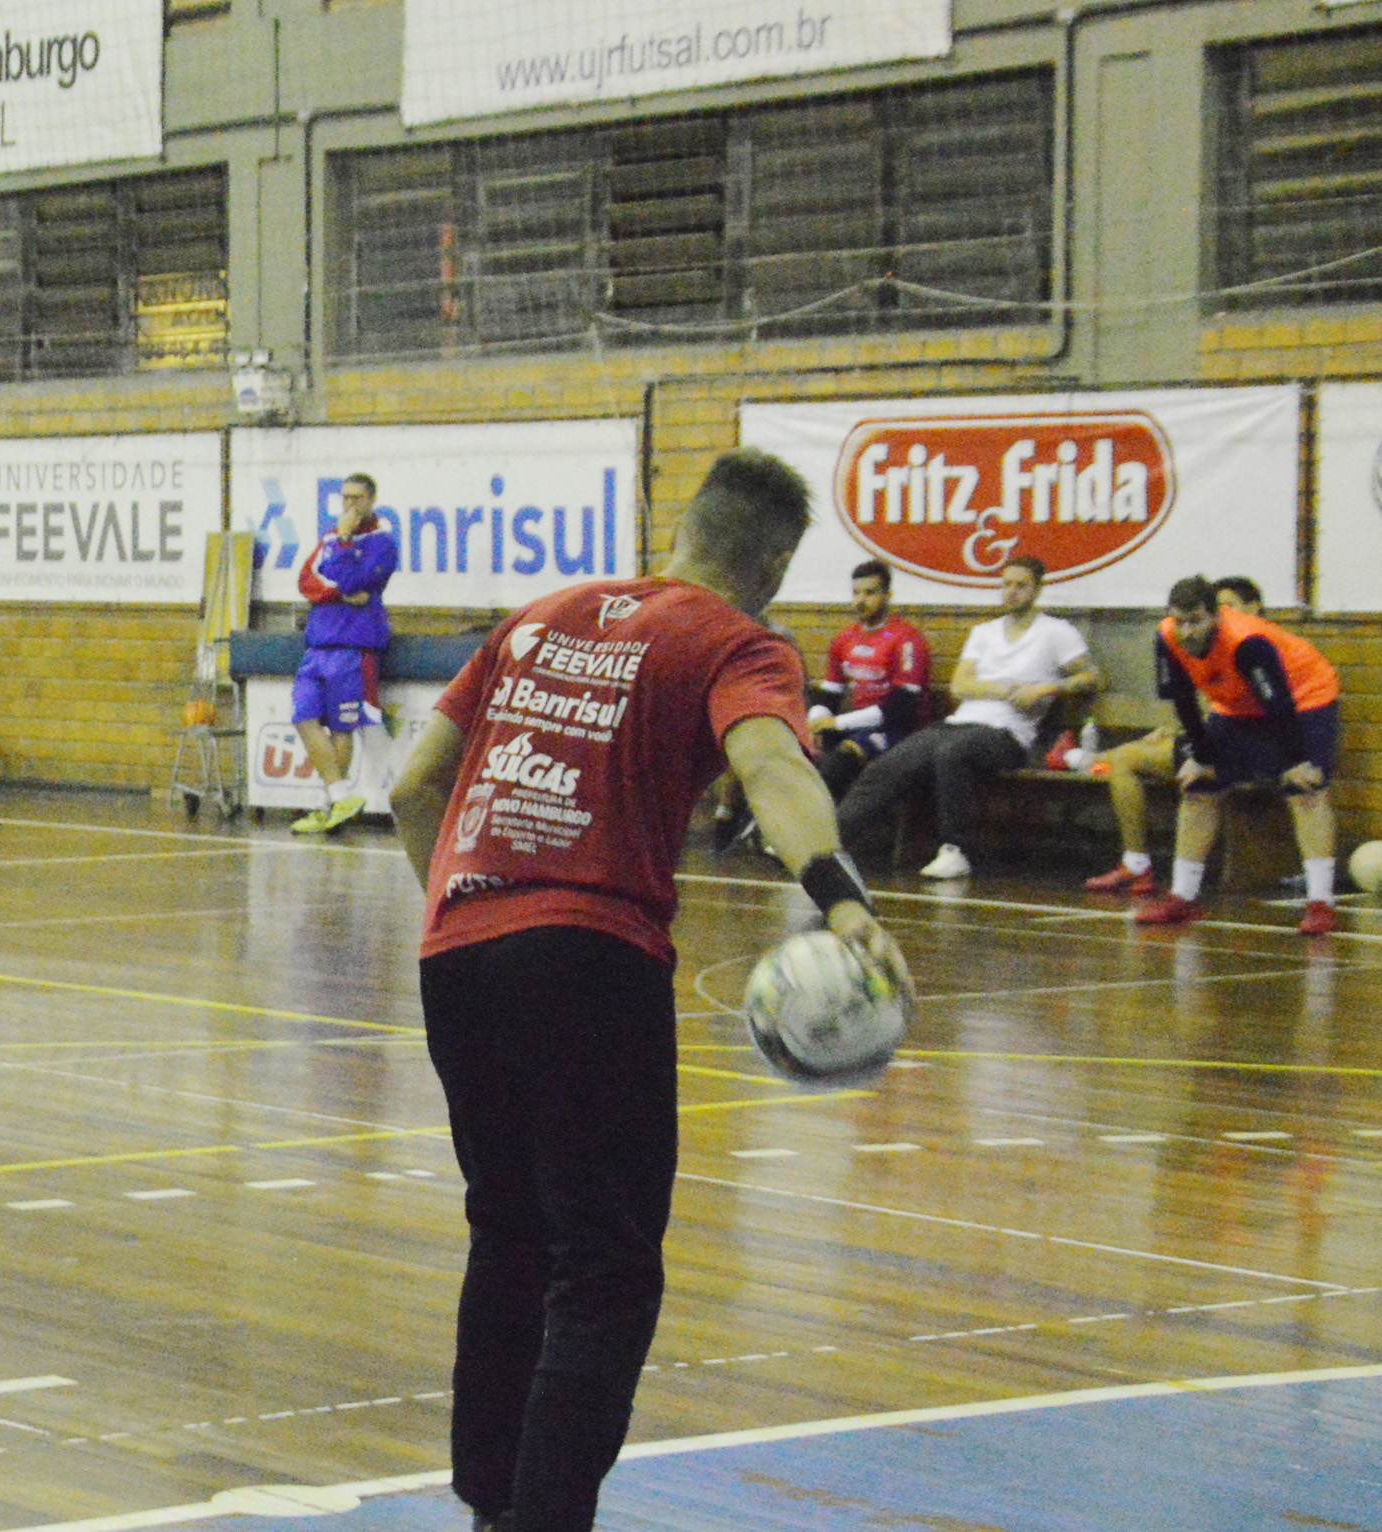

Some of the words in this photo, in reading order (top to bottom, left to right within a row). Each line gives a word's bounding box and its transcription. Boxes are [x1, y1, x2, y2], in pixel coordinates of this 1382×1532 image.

[496, 8, 833, 92] www.ujrfutsal.com.br
[857, 442, 981, 524] Fritz
[535, 642, 643, 682] FEEVALE
[546, 629, 651, 656] UNIVERSIDADE
[511, 677, 628, 729] Banrisul
